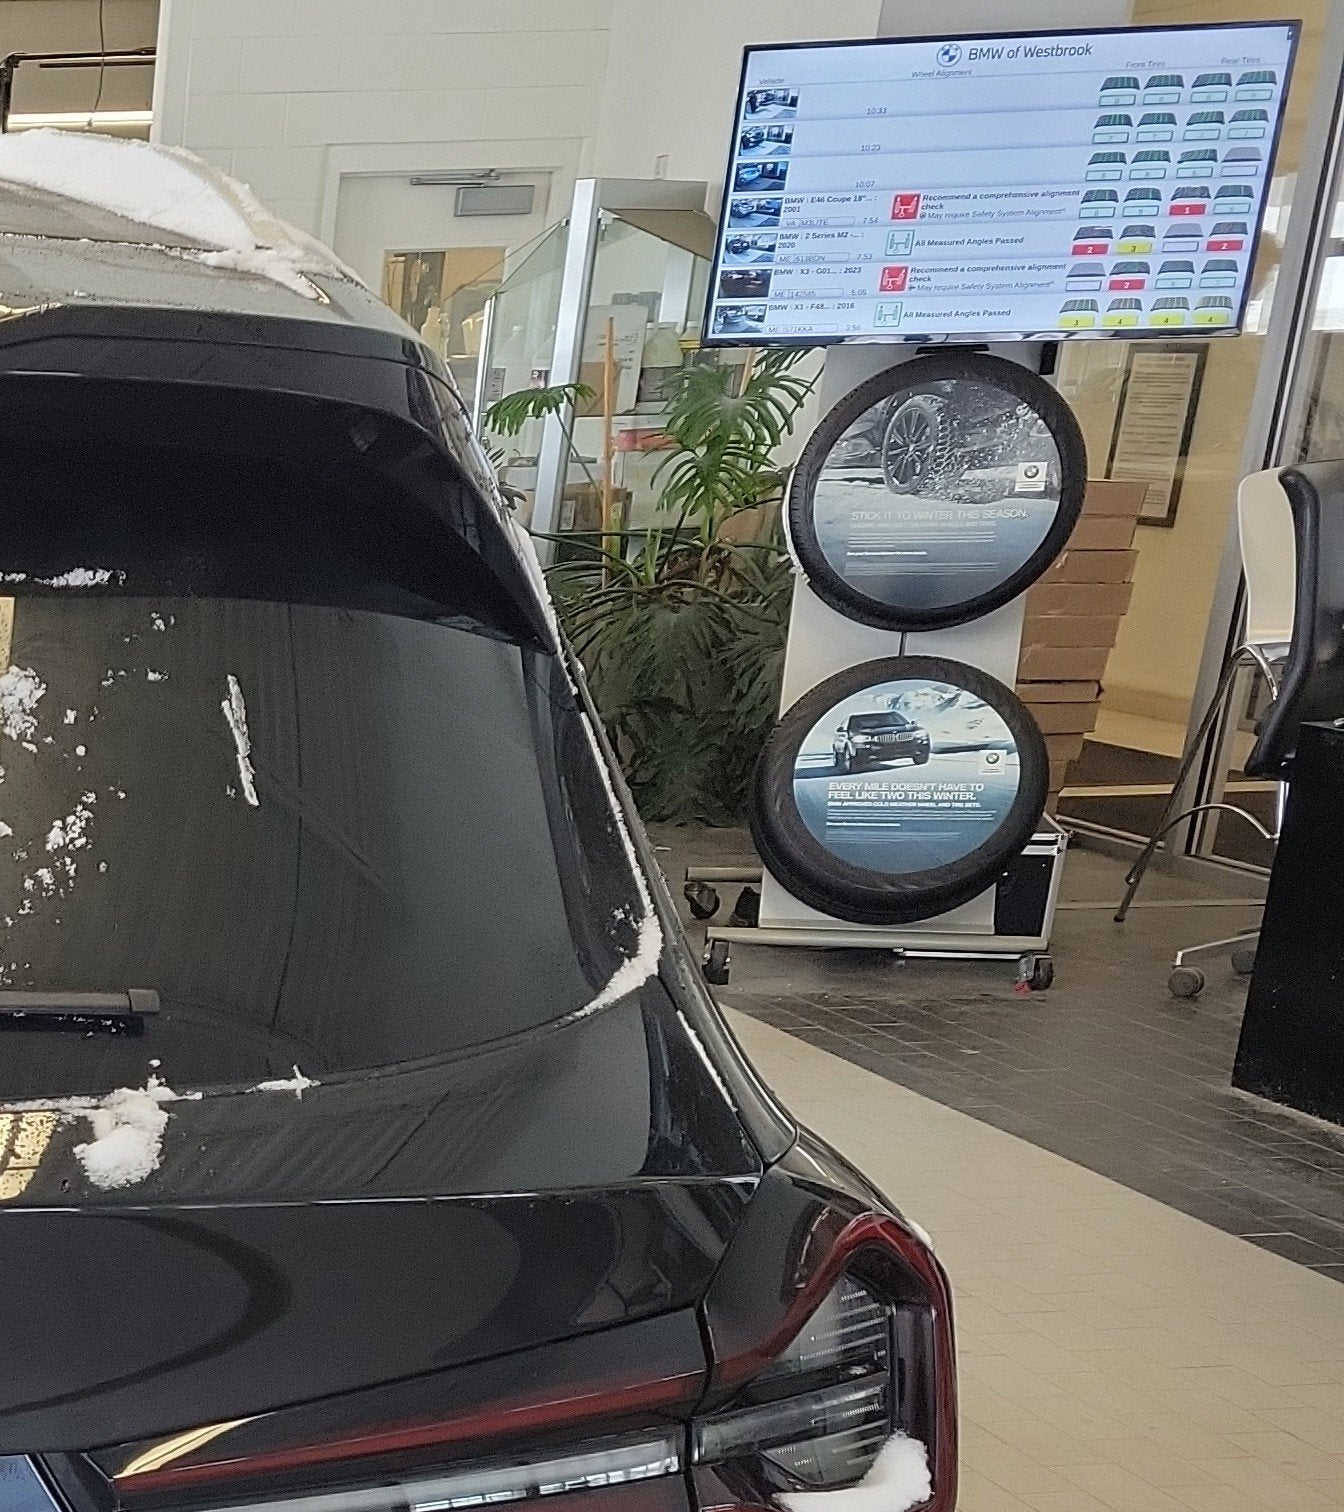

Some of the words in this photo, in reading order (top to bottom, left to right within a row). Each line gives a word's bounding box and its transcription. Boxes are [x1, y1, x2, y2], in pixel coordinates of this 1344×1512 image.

[968, 47, 1002, 61] BMW
[1007, 45, 1020, 60] of
[1021, 42, 1094, 59] Westbrook
[1145, 60, 1166, 68] Tires
[1242, 56, 1261, 64] Tires
[912, 70, 935, 78] Wheel
[936, 68, 973, 78] Alignment
[758, 77, 785, 86] Vehicle
[826, 196, 851, 205] Coupe
[922, 193, 971, 202] Recommend
[979, 191, 1039, 202] comprehensive
[1041, 189, 1080, 199] alignment
[921, 202, 944, 210] check
[927, 212, 944, 220] May
[945, 211, 970, 220] require
[972, 209, 992, 219] Safety
[995, 209, 1024, 218] System
[779, 232, 799, 240] BMW
[812, 231, 836, 239] Series
[778, 241, 796, 249] 2020
[915, 239, 927, 247] All
[928, 238, 965, 247] Measured
[966, 237, 994, 247] Angles
[995, 236, 1024, 245] Passed
[773, 268, 794, 276] BMW
[843, 266, 862, 274] 2023
[910, 266, 959, 275] Recommend
[966, 264, 1026, 274] comprehensive
[1027, 262, 1067, 272] alignment
[909, 275, 932, 283] check
[917, 285, 933, 293] May
[934, 284, 959, 293] require
[961, 282, 985, 291] Safety
[986, 281, 1013, 291] System
[916, 310, 952, 319] Measured
[954, 310, 981, 319] Angles
[982, 308, 1011, 317] Passed
[852, 510, 881, 520] STICK
[883, 510, 892, 520] IT
[897, 510, 911, 520] TO
[914, 510, 953, 520] WINTER
[957, 510, 980, 519] THIS
[983, 508, 1029, 519] SEASON.
[828, 782, 863, 791] EVERY
[864, 782, 890, 791] MILE
[891, 782, 936, 791] DOESN'T
[938, 782, 968, 791] HAVE
[970, 783, 985, 792] TO
[828, 791, 854, 800] FEEL
[856, 791, 879, 800] LIKE
[881, 792, 905, 800] TWO
[907, 791, 932, 800] THIS
[933, 791, 977, 801] WINTER.
